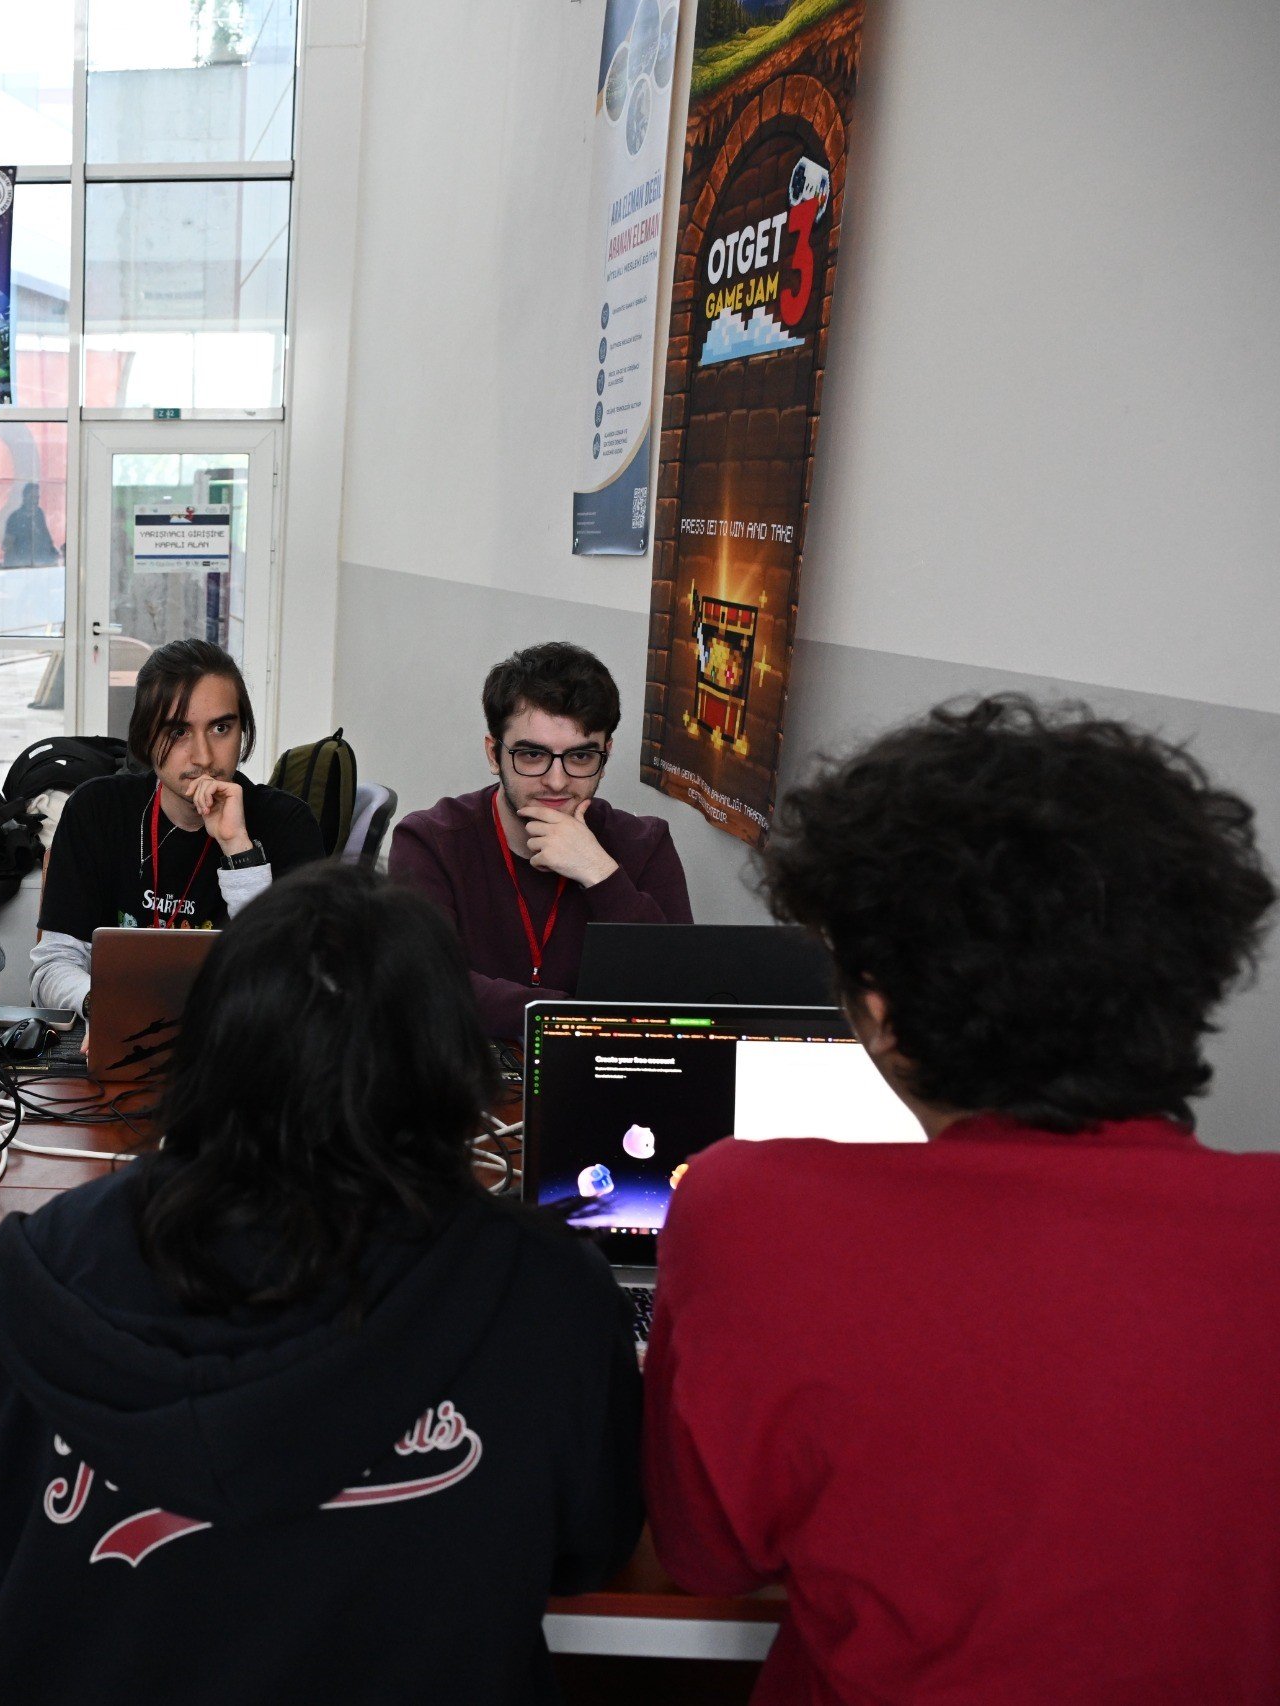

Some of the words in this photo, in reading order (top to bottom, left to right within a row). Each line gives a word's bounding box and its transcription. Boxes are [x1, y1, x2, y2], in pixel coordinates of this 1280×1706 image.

[632, 211, 661, 249] ELEMAN
[707, 211, 788, 285] OTGET
[780, 197, 820, 326] 3
[705, 282, 744, 319] GAME
[745, 271, 780, 307] JAM
[139, 530, 185, 539] YARIŞMACI
[154, 541, 185, 549] KAPALI
[187, 541, 210, 549] ALAN
[680, 518, 706, 535] PRESS
[719, 520, 728, 536] TO
[746, 522, 768, 540] AND
